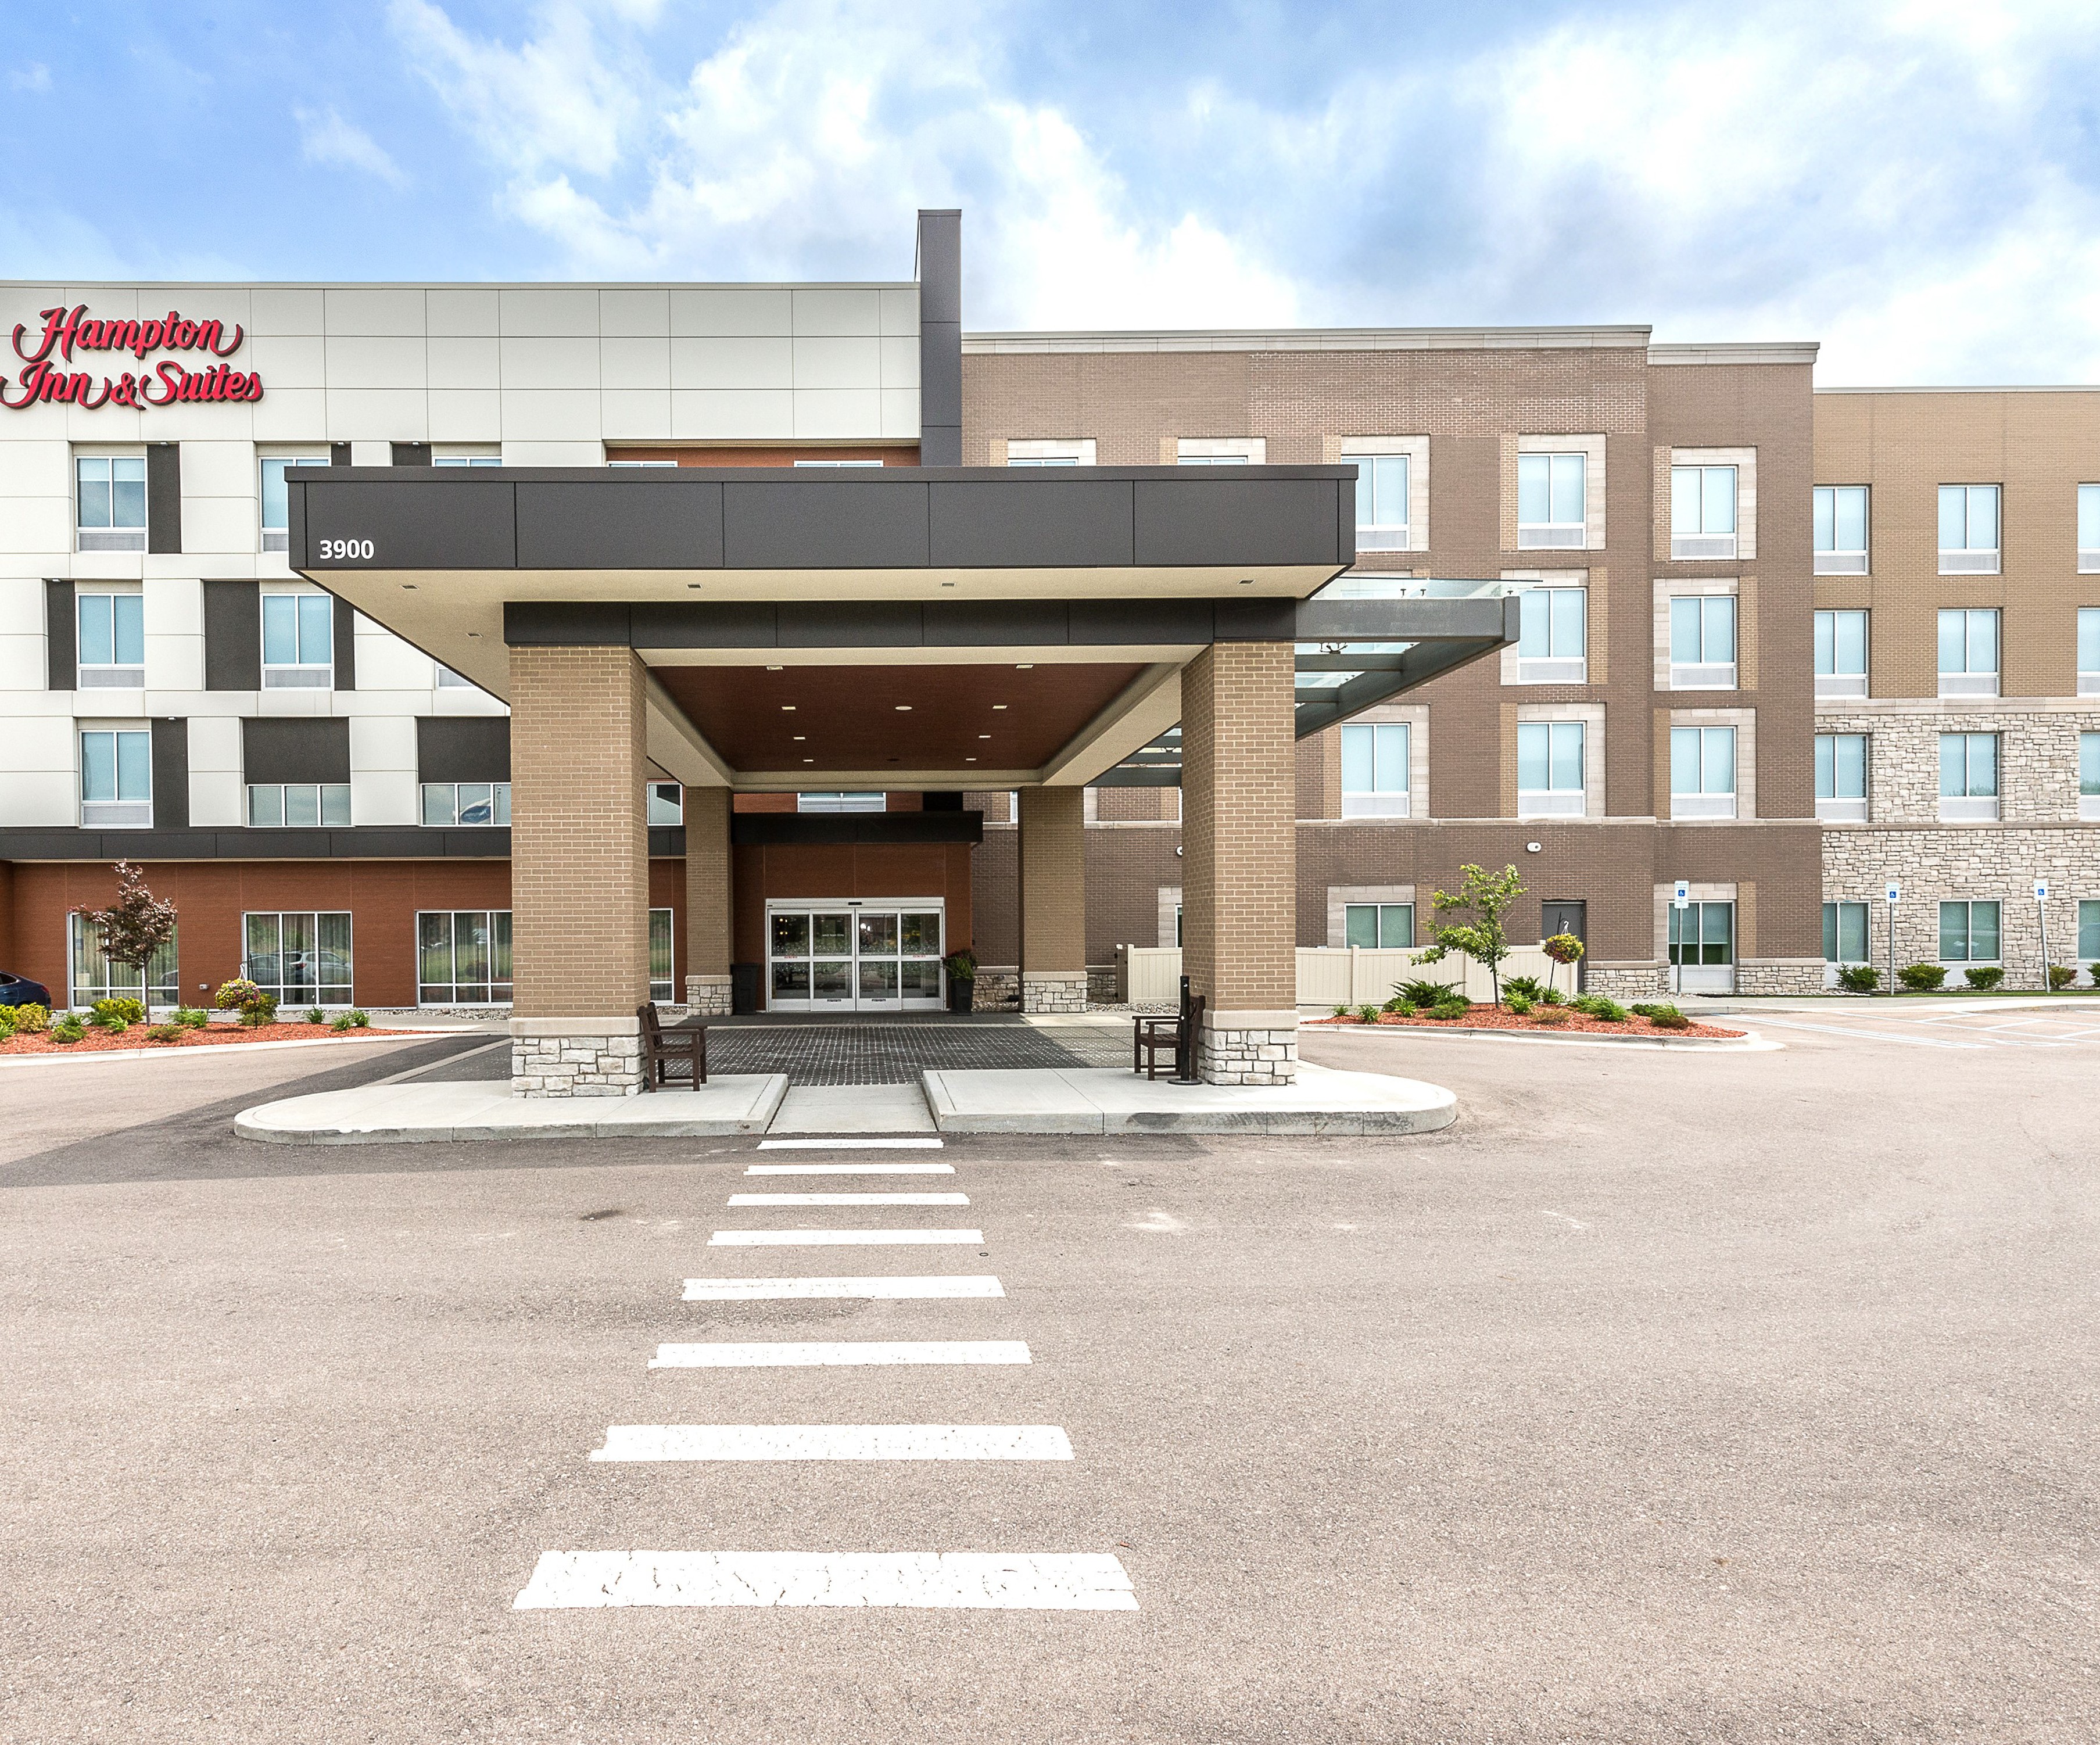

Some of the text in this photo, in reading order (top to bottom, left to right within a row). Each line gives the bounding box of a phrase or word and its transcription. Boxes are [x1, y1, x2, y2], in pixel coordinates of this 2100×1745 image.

[12, 304, 244, 363] Hampton
[0, 360, 264, 410] Inn & Suites
[320, 539, 374, 560] 3900
